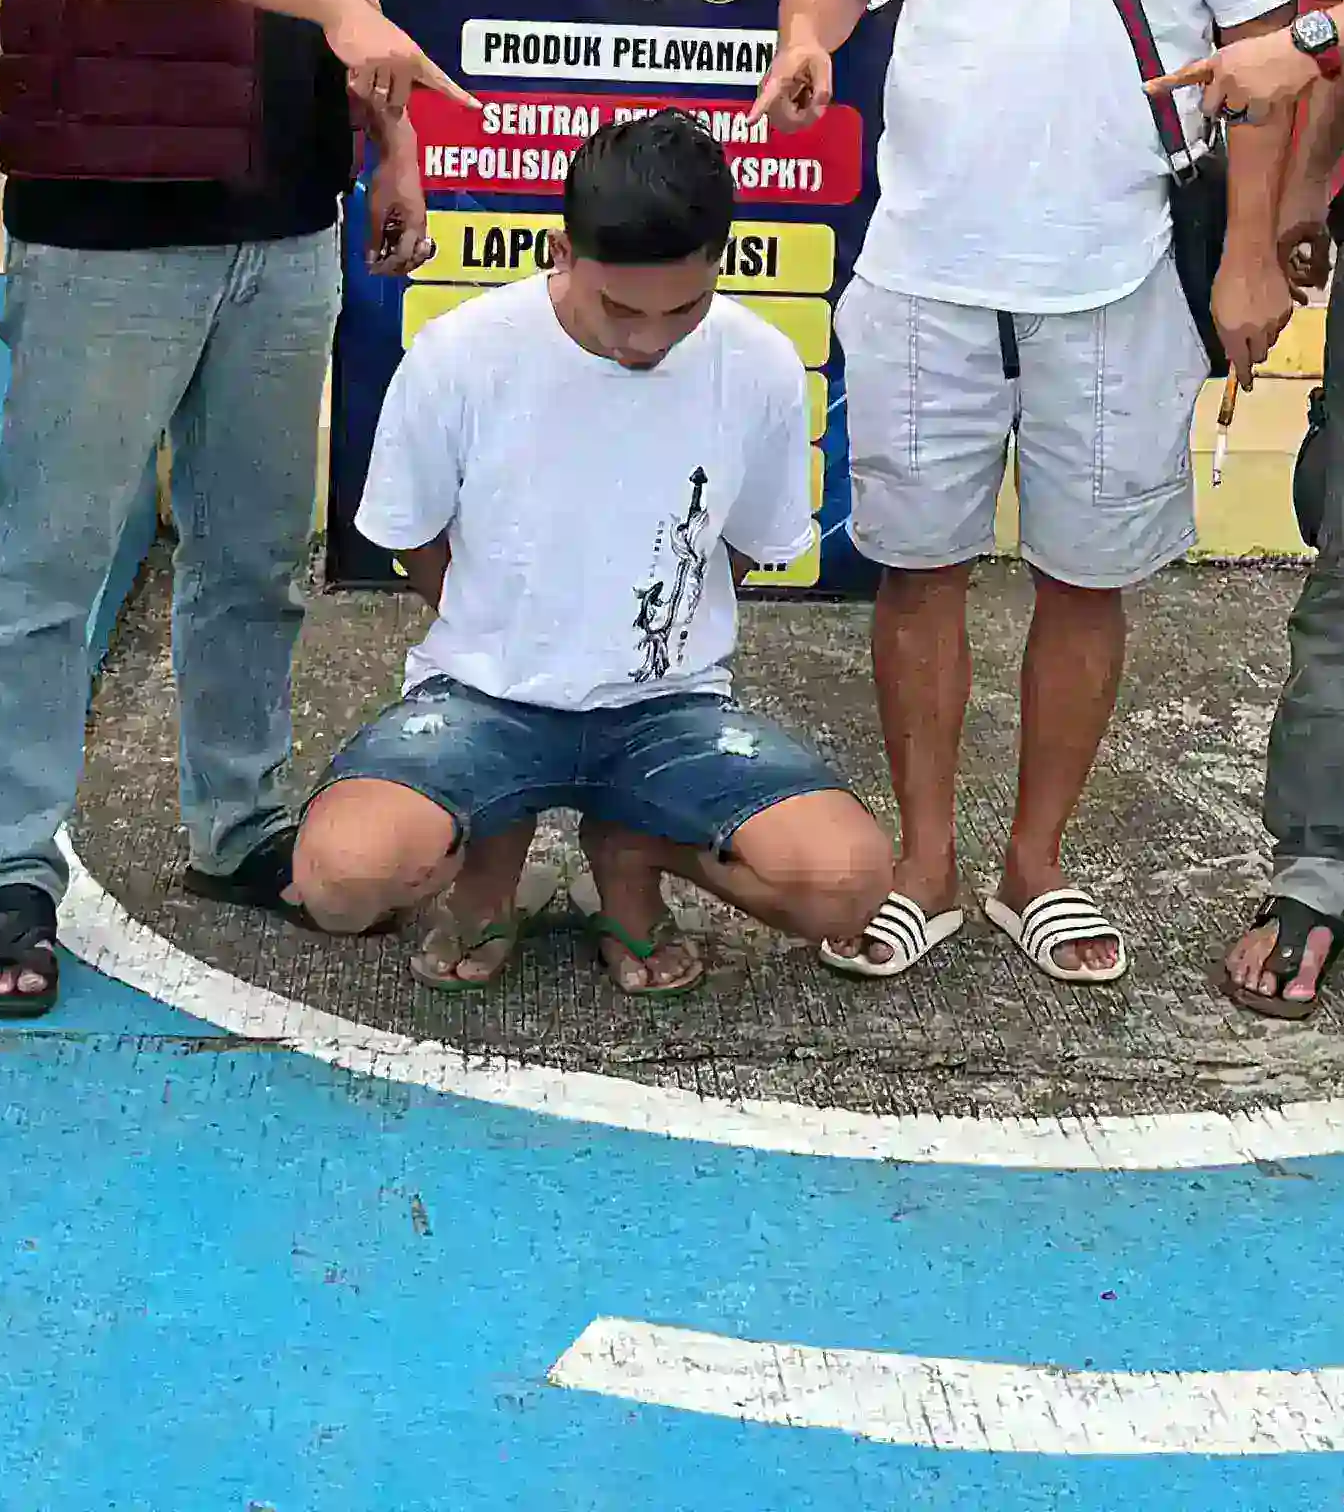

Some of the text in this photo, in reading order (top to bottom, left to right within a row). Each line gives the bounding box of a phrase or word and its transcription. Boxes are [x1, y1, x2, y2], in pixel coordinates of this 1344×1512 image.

[484, 31, 774, 74] PRODUK PELAYANAN
[424, 145, 824, 192] KEPOLISIA (SPKT)
[462, 225, 555, 269] LAPO
